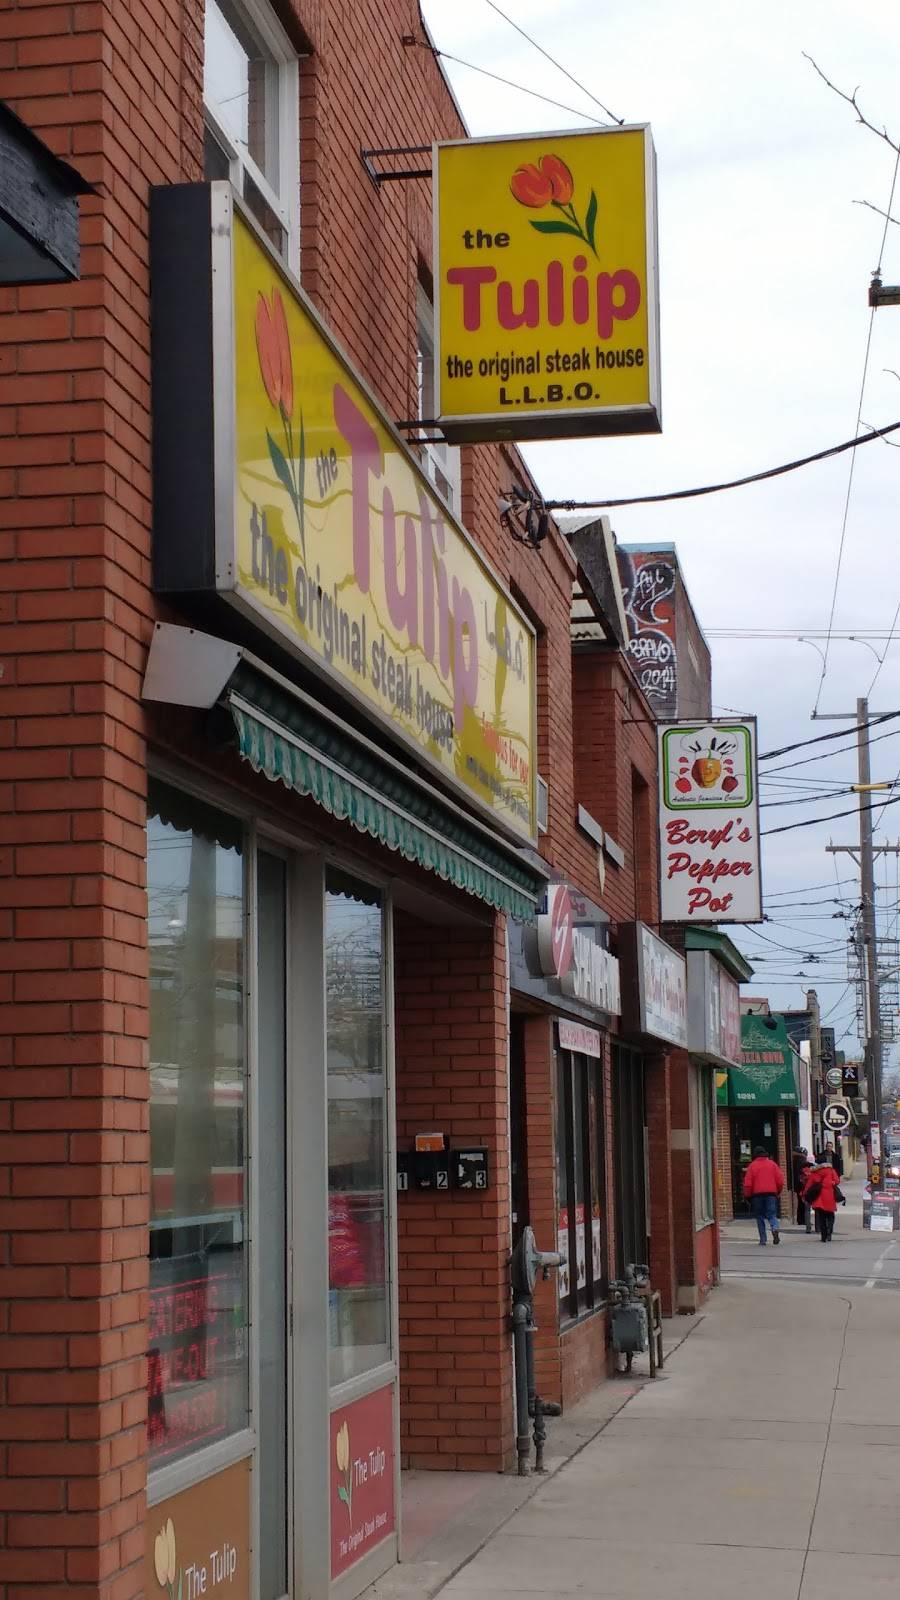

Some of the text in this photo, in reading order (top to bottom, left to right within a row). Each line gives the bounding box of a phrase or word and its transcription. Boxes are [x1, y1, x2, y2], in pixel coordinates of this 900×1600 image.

[462, 229, 510, 249] the
[446, 255, 641, 339] Tulip
[447, 346, 644, 381] the original steak house
[499, 382, 601, 405] L.L.B.O.
[316, 447, 338, 498] the
[334, 383, 479, 731] Tulip
[250, 502, 453, 754] the original steak house
[665, 817, 753, 850] Beryl's
[667, 852, 754, 884] Pepper
[687, 887, 733, 915] Pot
[437, 1172, 447, 1188] 2
[477, 1172, 485, 1187] 3
[354, 1446, 386, 1488] The Tulip
[185, 1543, 237, 1600] The Tulip
